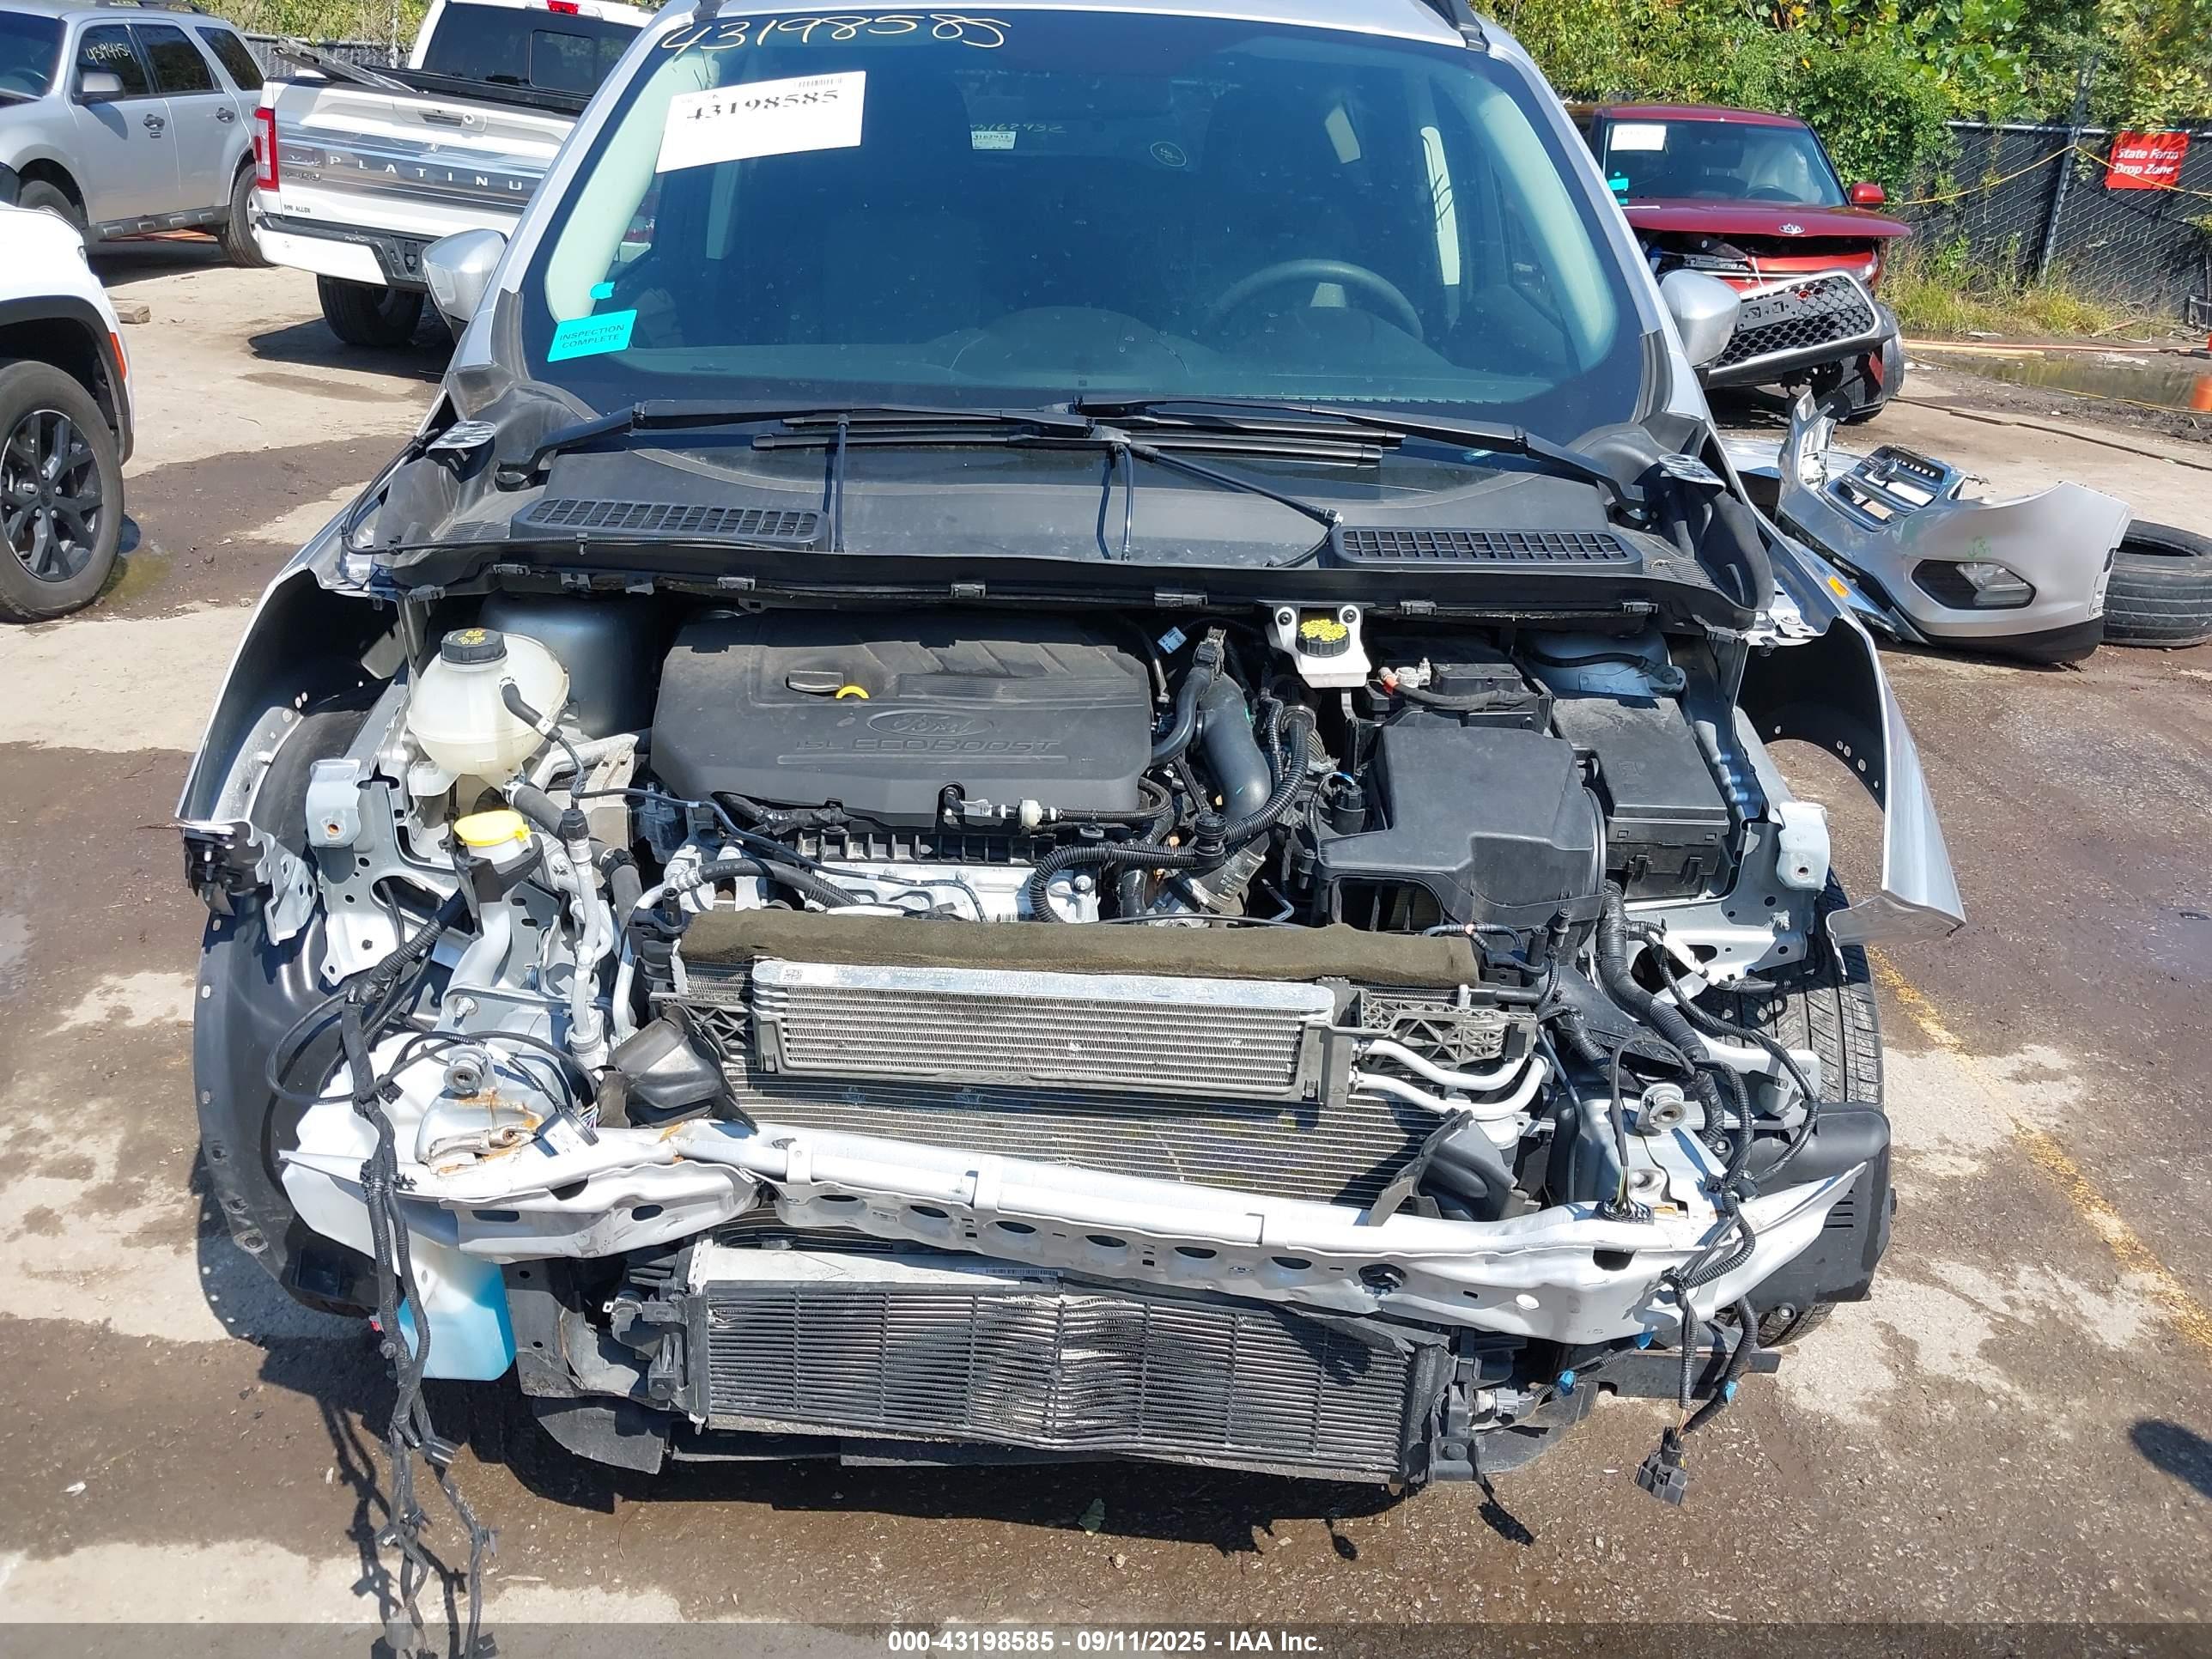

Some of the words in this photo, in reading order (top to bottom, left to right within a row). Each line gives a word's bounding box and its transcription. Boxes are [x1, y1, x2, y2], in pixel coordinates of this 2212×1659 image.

[661, 14, 1012, 57] 43198585
[687, 89, 839, 120] 43198585
[2117, 149, 2148, 160] State
[2149, 149, 2179, 160] Farm
[329, 155, 523, 191] PLATINU
[2114, 162, 2143, 176] Drop
[2144, 163, 2175, 174] Zone
[560, 324, 625, 341] INSPECTION
[562, 333, 621, 349] COMPLETE
